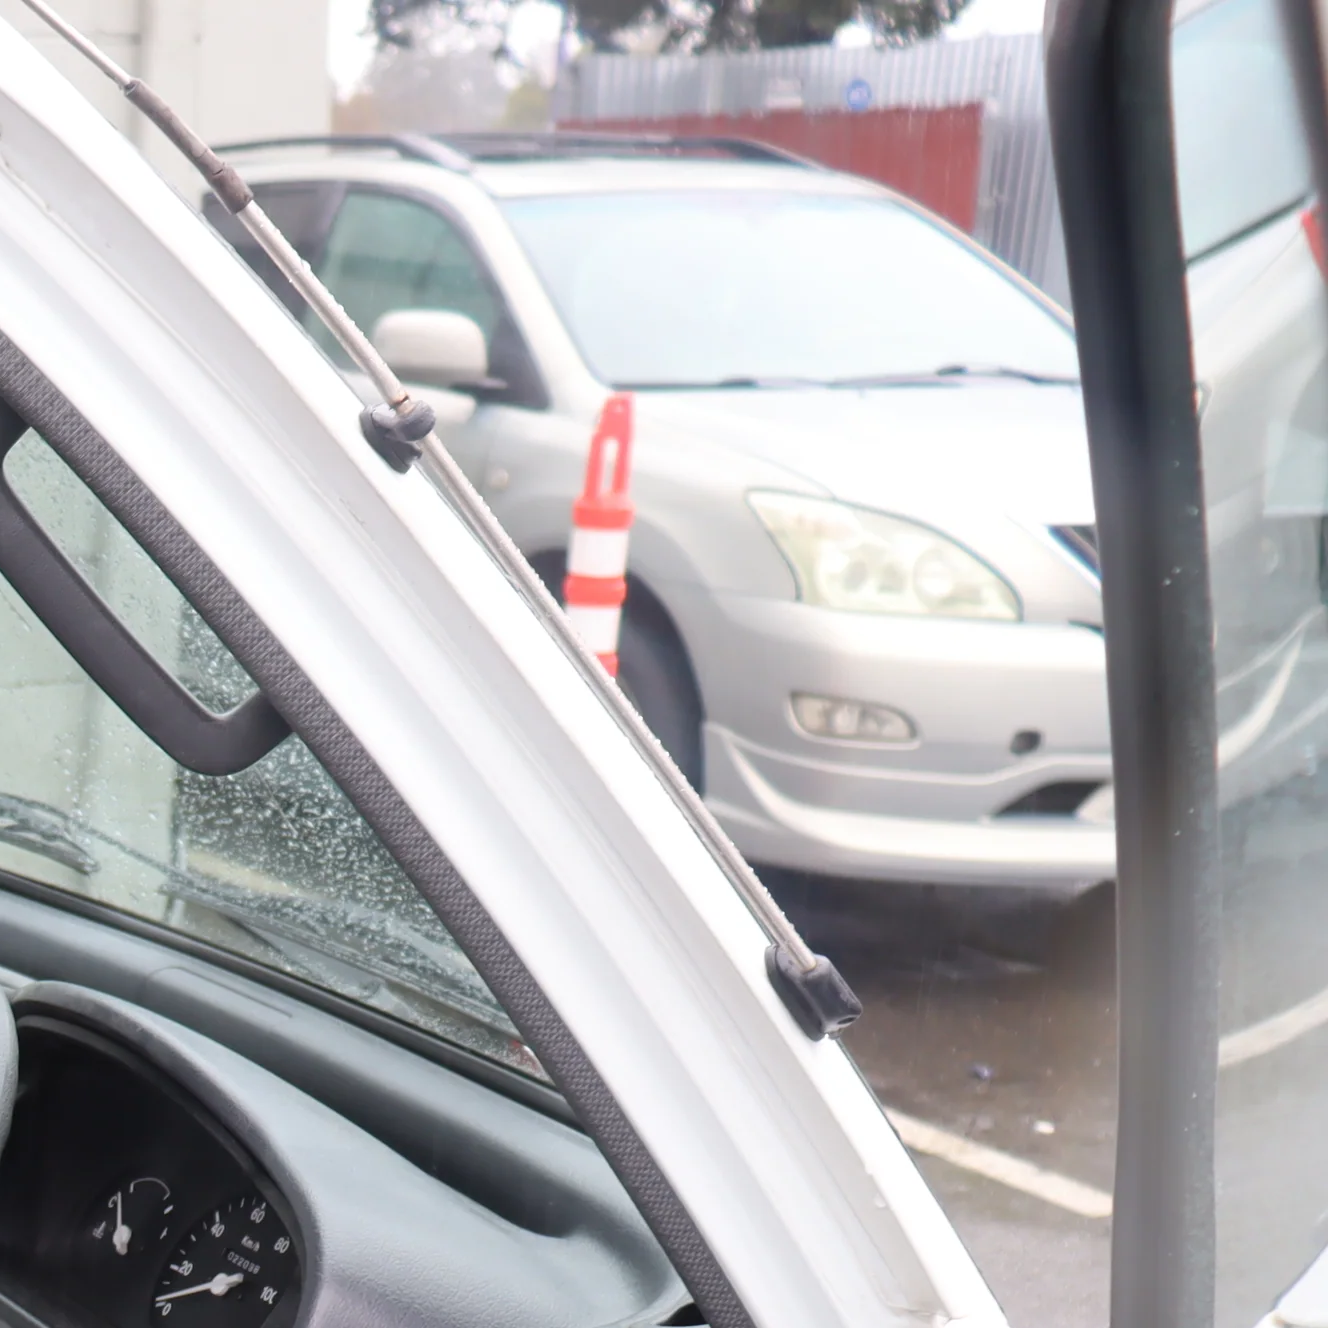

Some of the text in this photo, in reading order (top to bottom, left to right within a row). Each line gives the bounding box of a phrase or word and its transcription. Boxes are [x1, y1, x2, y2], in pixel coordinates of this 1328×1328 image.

[250, 1208, 266, 1224] 60
[211, 1222, 225, 1238] 40
[273, 1237, 290, 1253] 80
[179, 1260, 193, 1276] 20
[161, 1303, 171, 1316] 0
